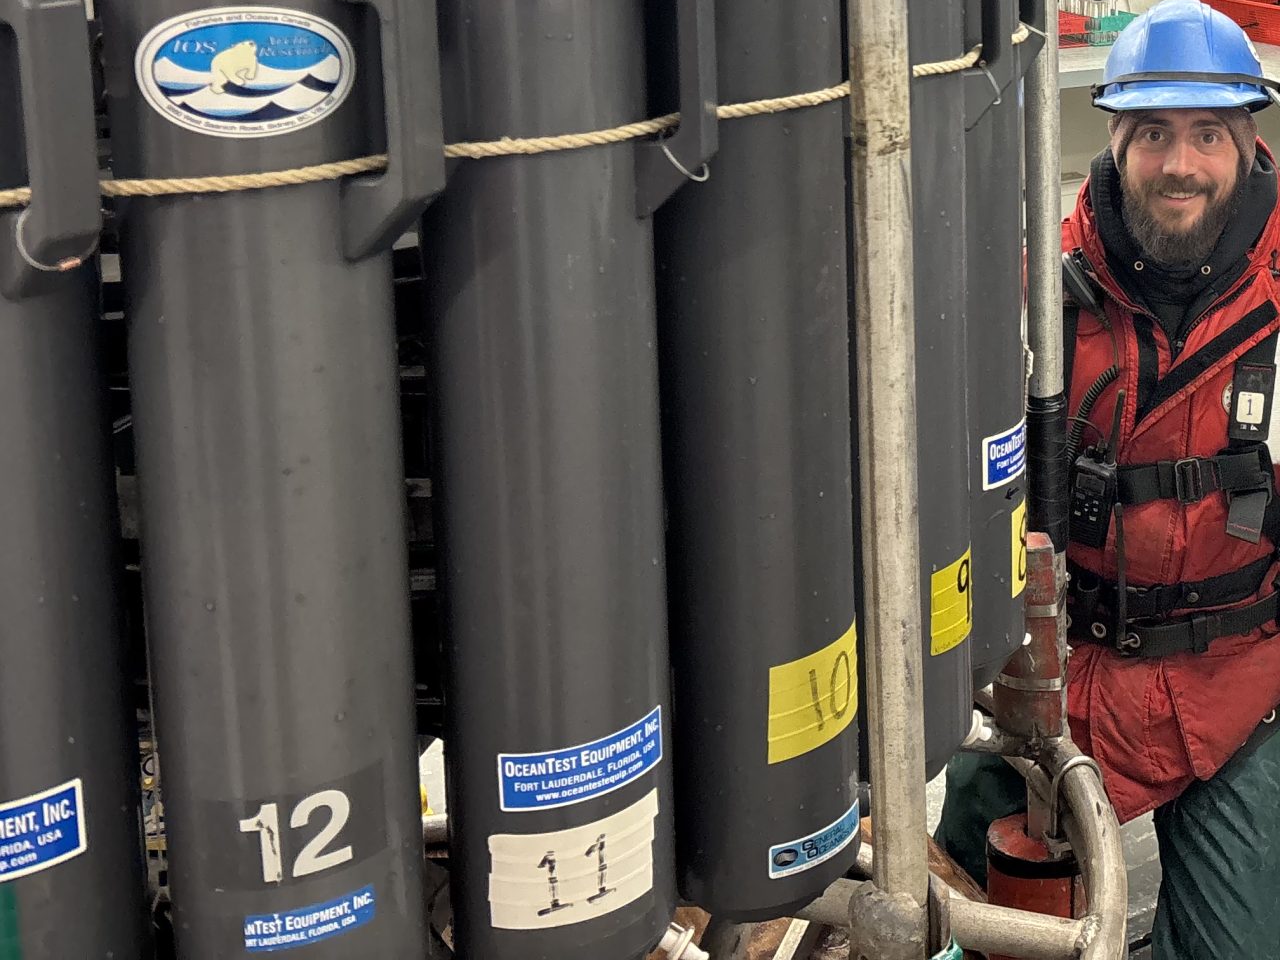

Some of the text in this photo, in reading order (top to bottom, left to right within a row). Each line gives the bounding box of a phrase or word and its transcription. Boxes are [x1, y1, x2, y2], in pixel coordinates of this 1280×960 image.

[184, 13, 311, 29] Fisheries and Oceans Canada
[173, 39, 218, 55] IOS
[1245, 398, 1253, 416] 1
[957, 559, 970, 625] 9
[808, 650, 851, 731] 10
[643, 739, 656, 754] USA
[536, 760, 643, 802] www.oceantestequip.com
[42, 798, 75, 827] INC.
[37, 829, 62, 846] USA
[239, 789, 353, 883] 12
[537, 834, 617, 917] 11
[341, 915, 356, 927] USA
